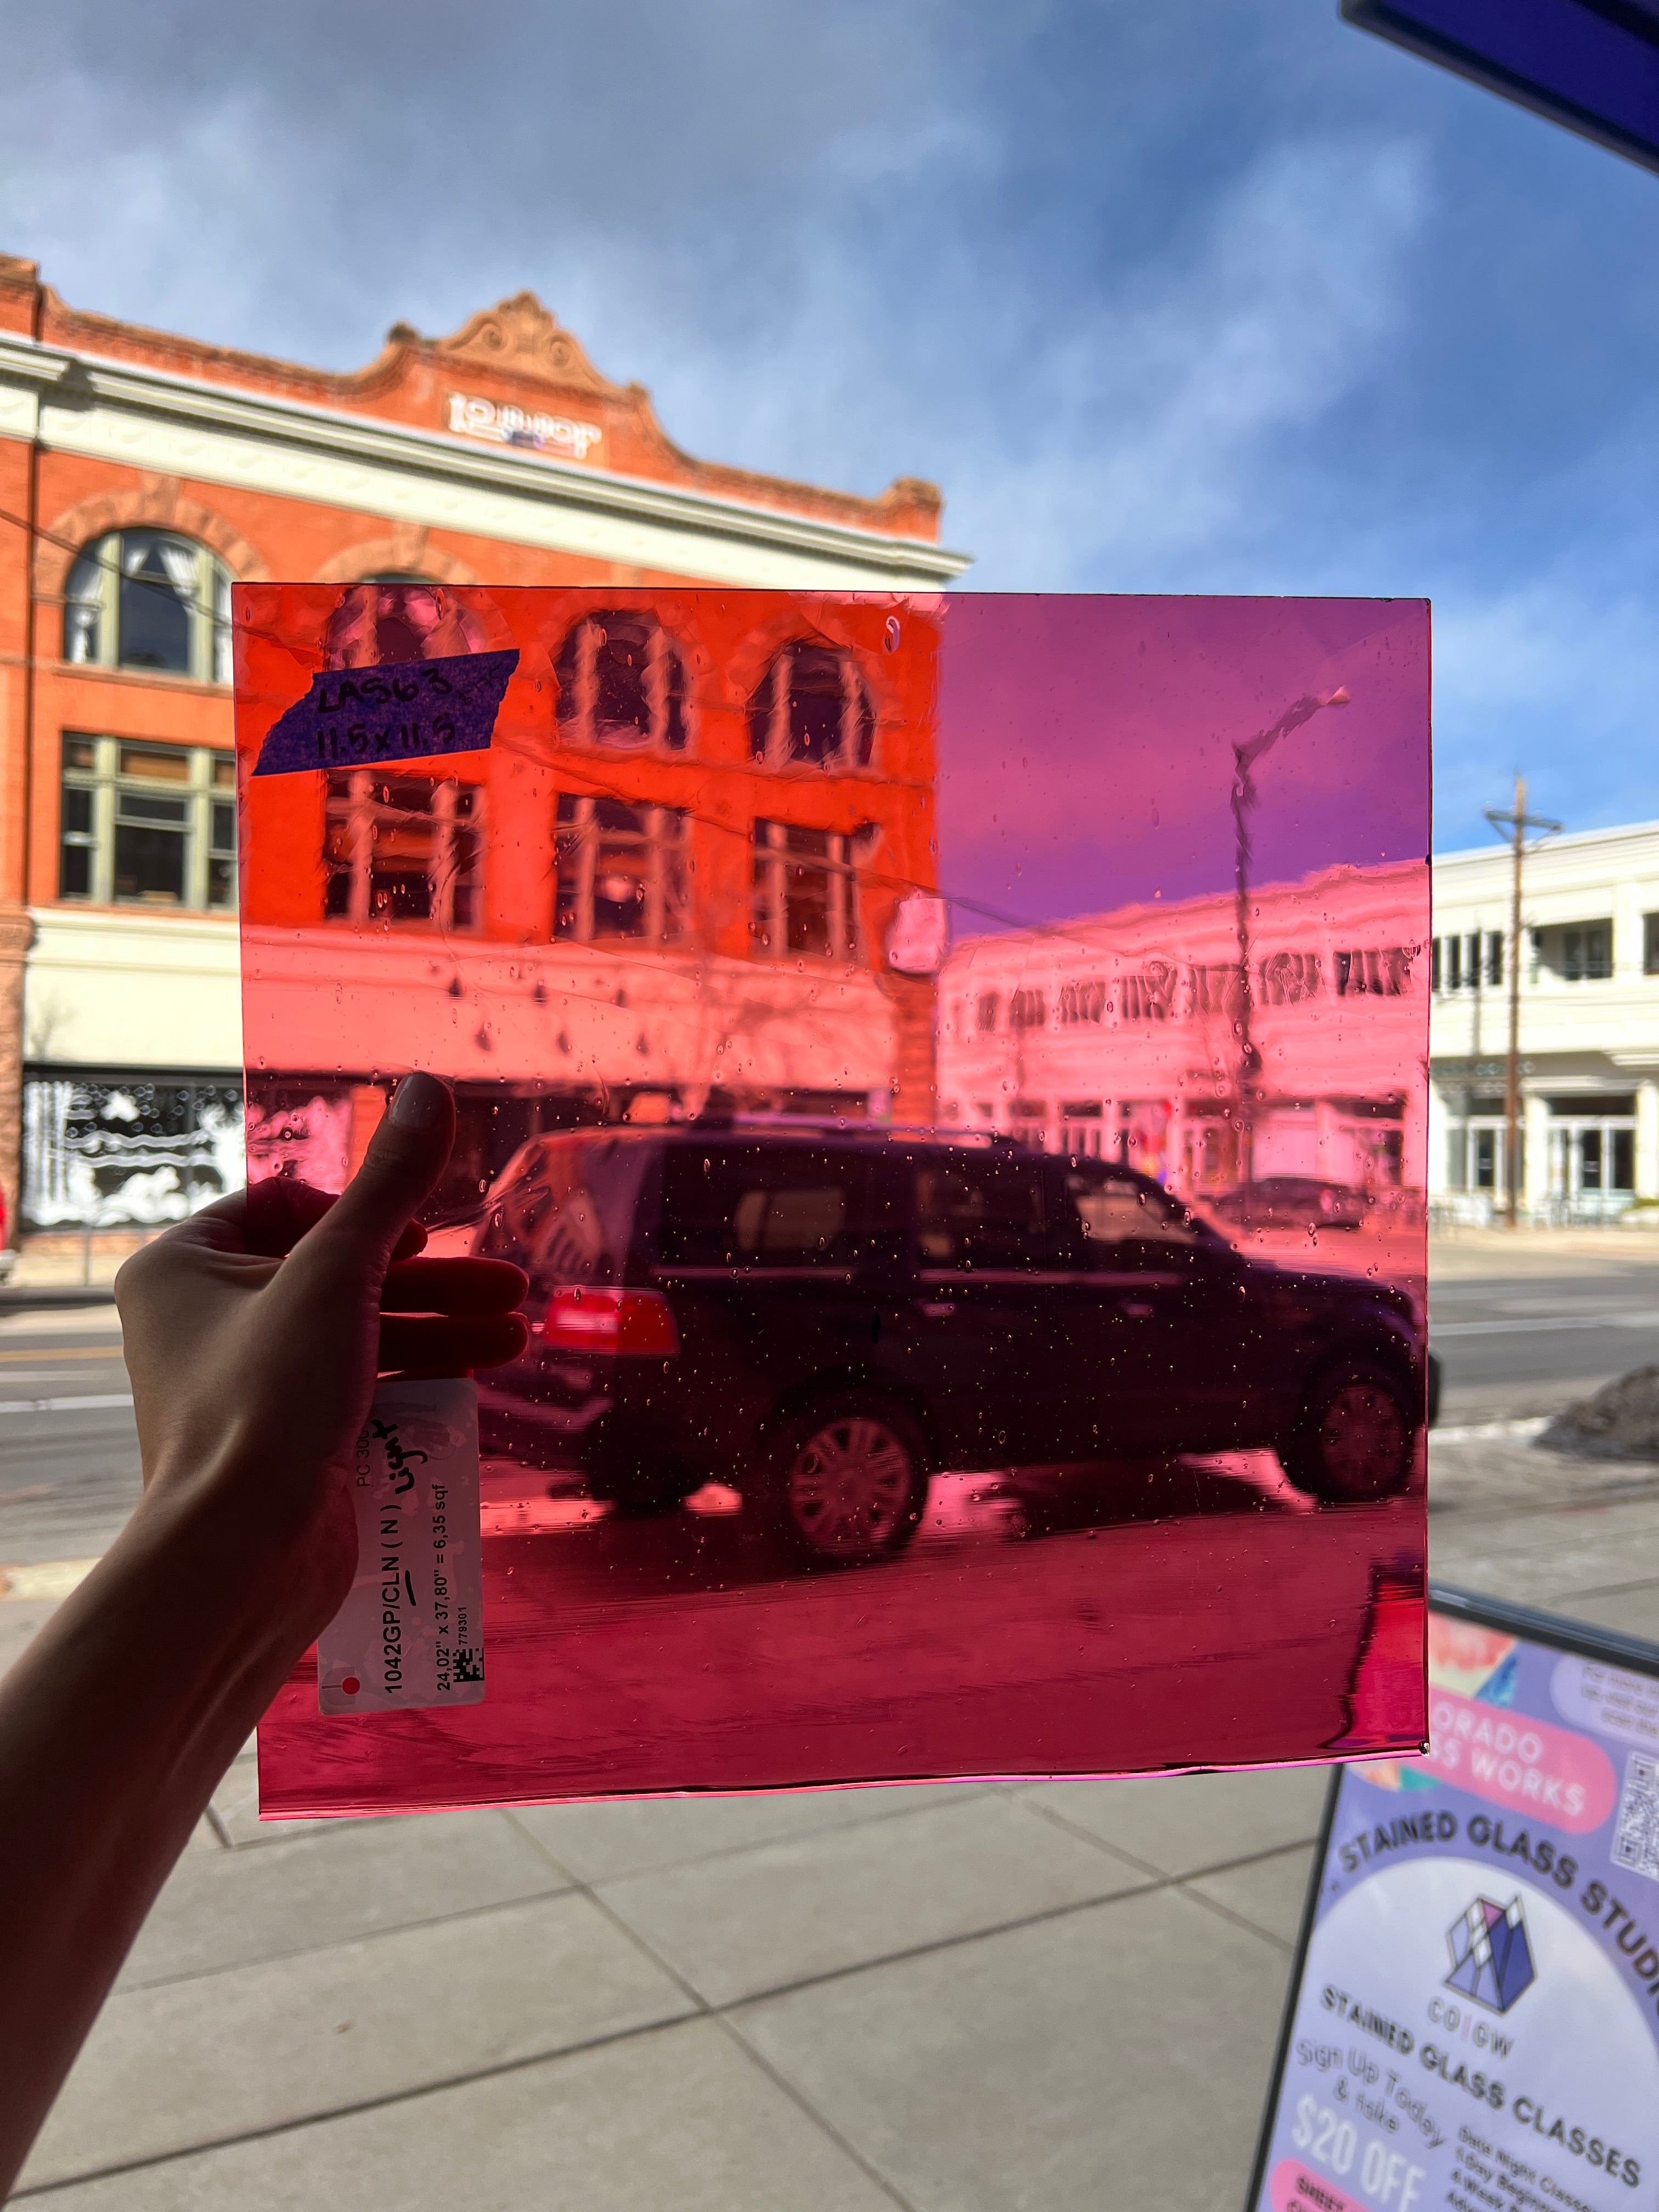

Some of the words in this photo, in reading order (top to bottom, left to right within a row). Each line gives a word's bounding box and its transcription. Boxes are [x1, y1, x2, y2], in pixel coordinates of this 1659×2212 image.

[357, 1464, 371, 1487] PC
[432, 1484, 449, 1510] sqf
[433, 1515, 449, 1549] 6,35
[434, 1570, 451, 1620] 37,80"
[381, 1555, 403, 1694] 1042GP/CLN
[440, 1626, 449, 1635] x
[458, 1606, 469, 1645] 779301
[435, 1640, 452, 1692] 24,02"
[1432, 1702, 1544, 1764] ORADO
[1471, 1749, 1585, 1817] WORKS
[1339, 1811, 1458, 1874] STAINED
[1467, 1815, 1579, 1889] GLASS
[1581, 1879, 1659, 2017] STUD
[1320, 1984, 1415, 2055] STAINED
[1420, 2042, 1505, 2109] GLASS
[1513, 2097, 1641, 2188] CLASSES
[1291, 2094, 1357, 2175] $20
[1361, 2140, 1426, 2212] OFF
